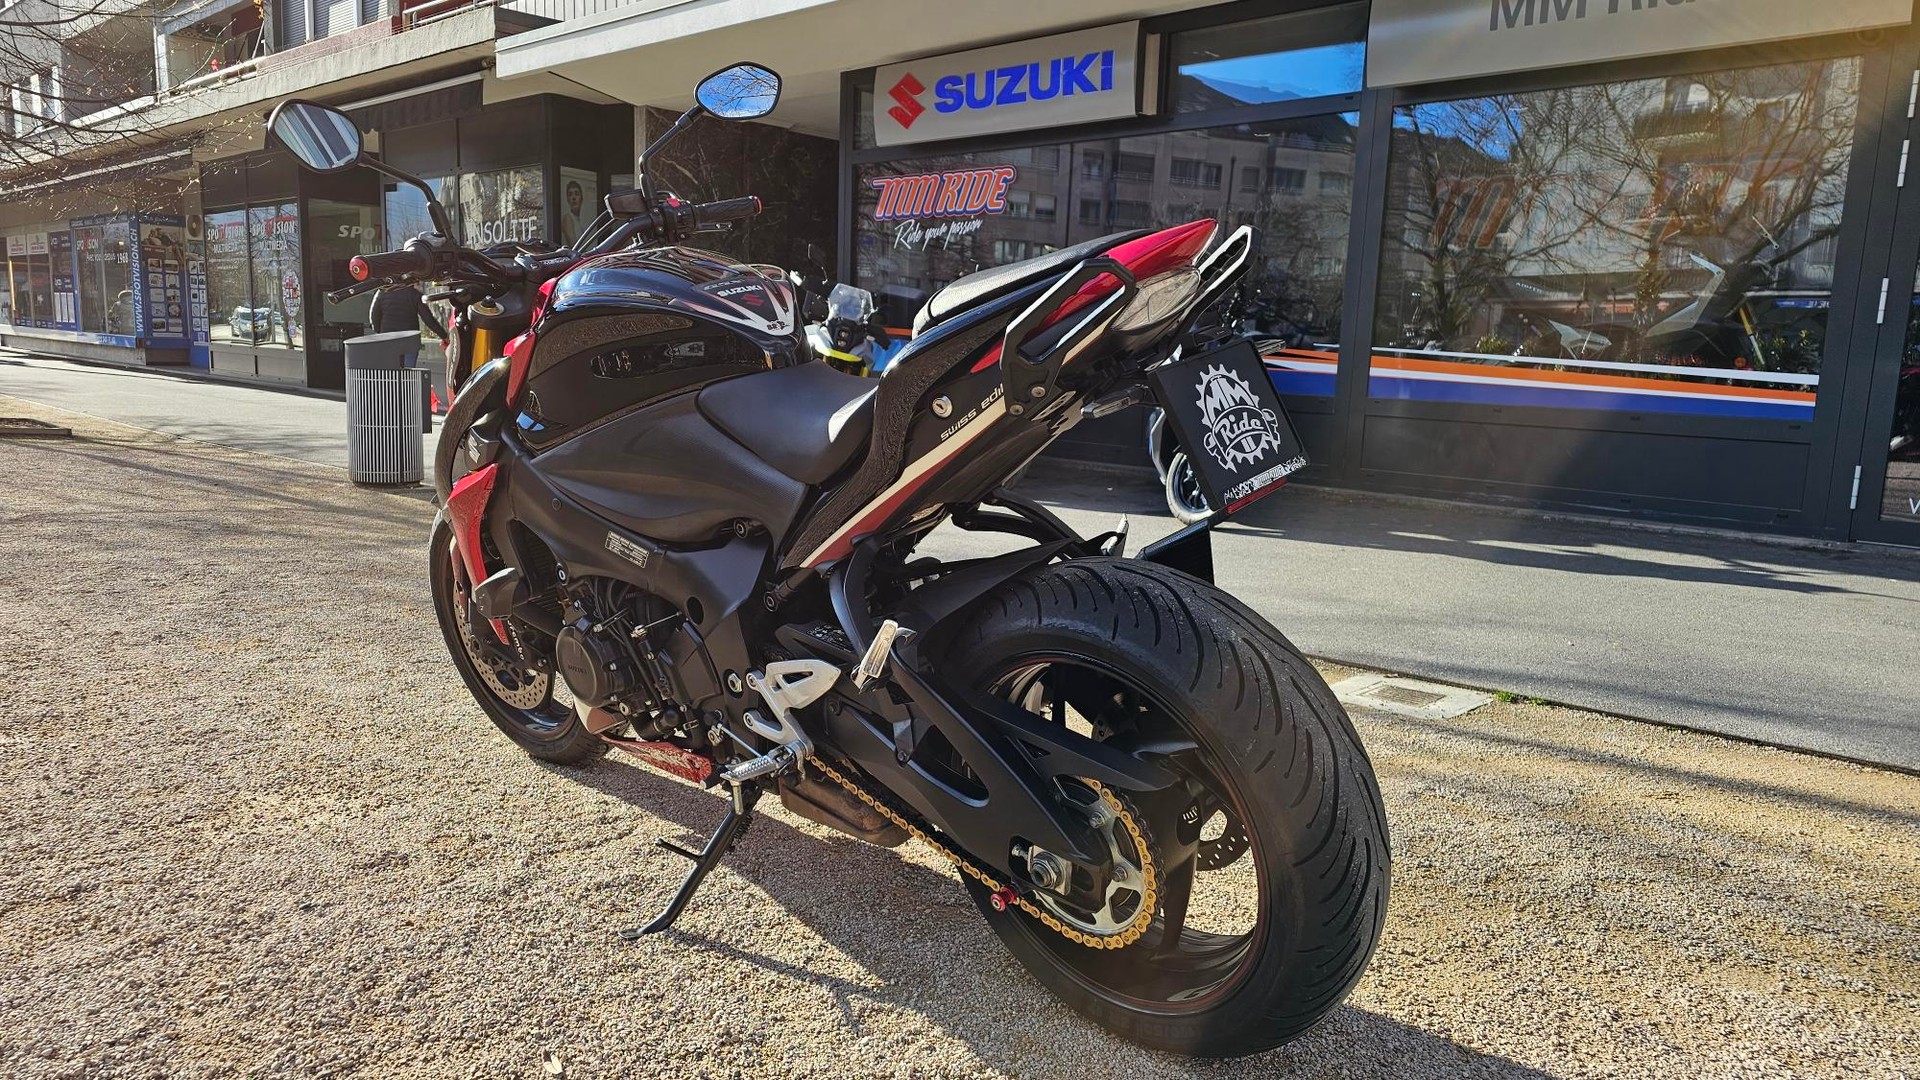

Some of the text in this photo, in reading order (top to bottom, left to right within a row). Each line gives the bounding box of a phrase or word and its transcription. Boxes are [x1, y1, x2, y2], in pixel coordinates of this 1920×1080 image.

[934, 50, 1115, 114] SUZUKI
[872, 165, 1017, 220] MM RIDE
[467, 215, 537, 247] INSOLITE
[893, 219, 921, 250] Ride
[943, 215, 983, 251] passion
[130, 228, 144, 332] WWW.SPOTVISION.CH
[717, 285, 763, 297] SUZUKI
[940, 408, 977, 441] swiss
[1215, 412, 1264, 446] Ride
